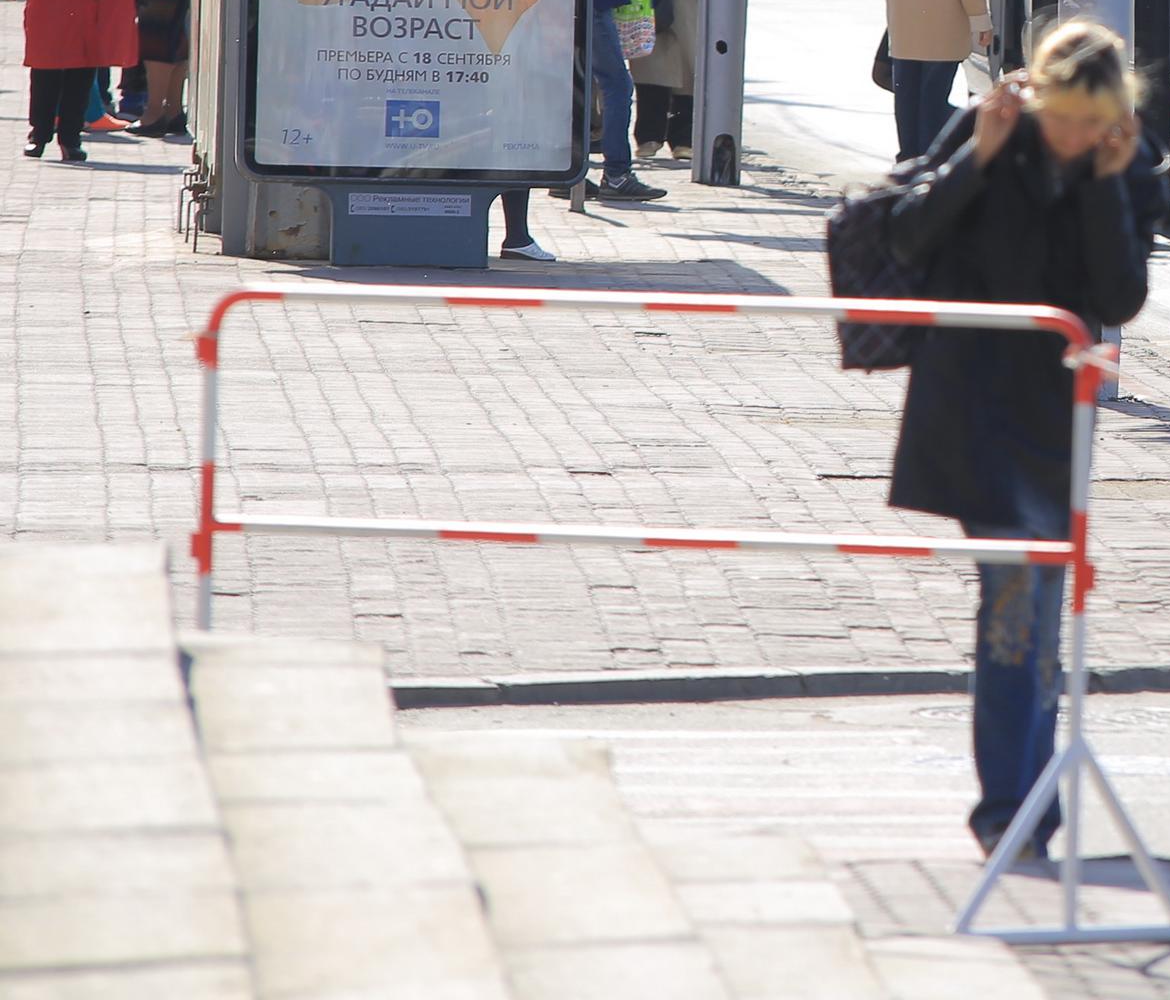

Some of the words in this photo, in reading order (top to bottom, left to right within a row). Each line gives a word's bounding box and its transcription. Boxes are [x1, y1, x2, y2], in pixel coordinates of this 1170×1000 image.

[352, 16, 481, 41] ВОЗРАСТ
[317, 49, 394, 64] ПРЕМЬЕРА
[398, 51, 409, 64] С
[413, 52, 432, 64] 18
[437, 52, 511, 66] СЕНТЯБРЯ
[338, 68, 361, 81] ПО
[366, 69, 427, 84] БУДНЯМ
[432, 71, 441, 83] В
[446, 71, 489, 84] 17:40
[399, 88, 440, 96] ТЕЛЕКАНАЛЕ
[281, 128, 313, 146] 12+
